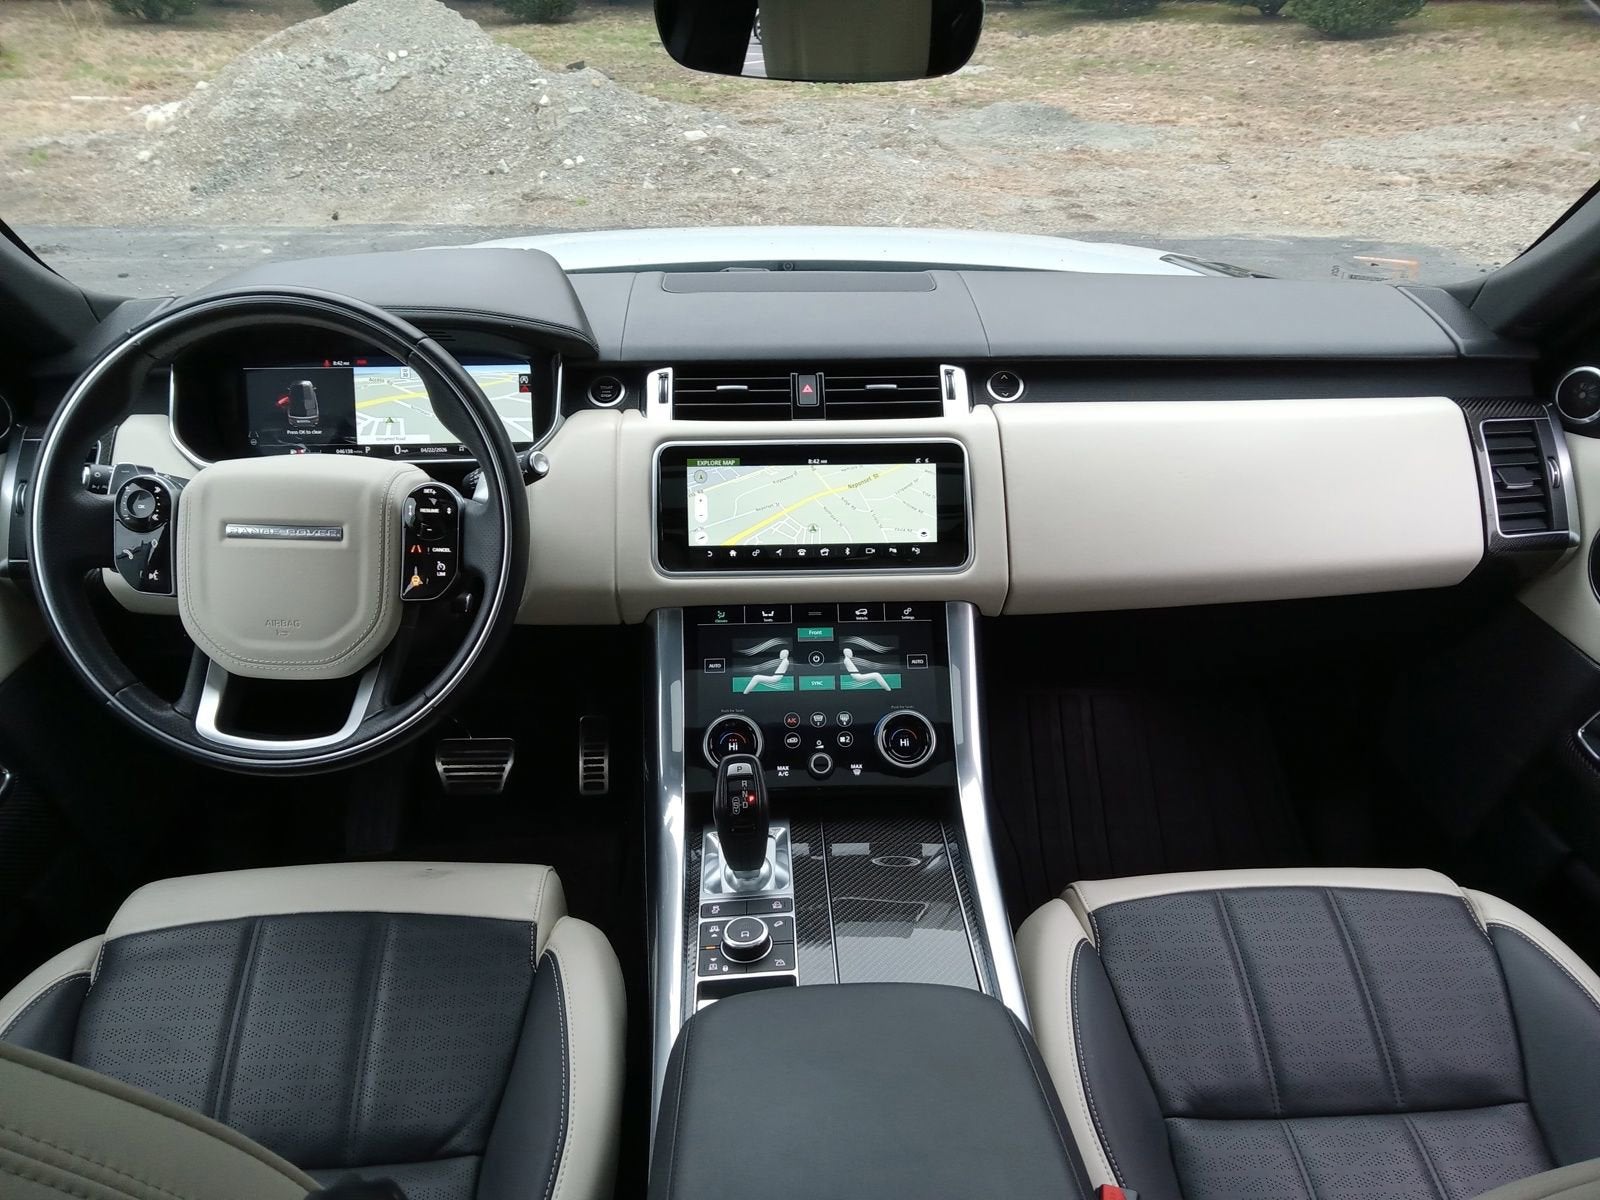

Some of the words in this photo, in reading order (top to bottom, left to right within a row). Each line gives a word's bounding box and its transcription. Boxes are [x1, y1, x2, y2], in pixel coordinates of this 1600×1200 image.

[394, 445, 400, 454] 0
[265, 619, 301, 628] AIRBAG
[728, 742, 738, 750] Hi
[900, 738, 910, 747] Hi
